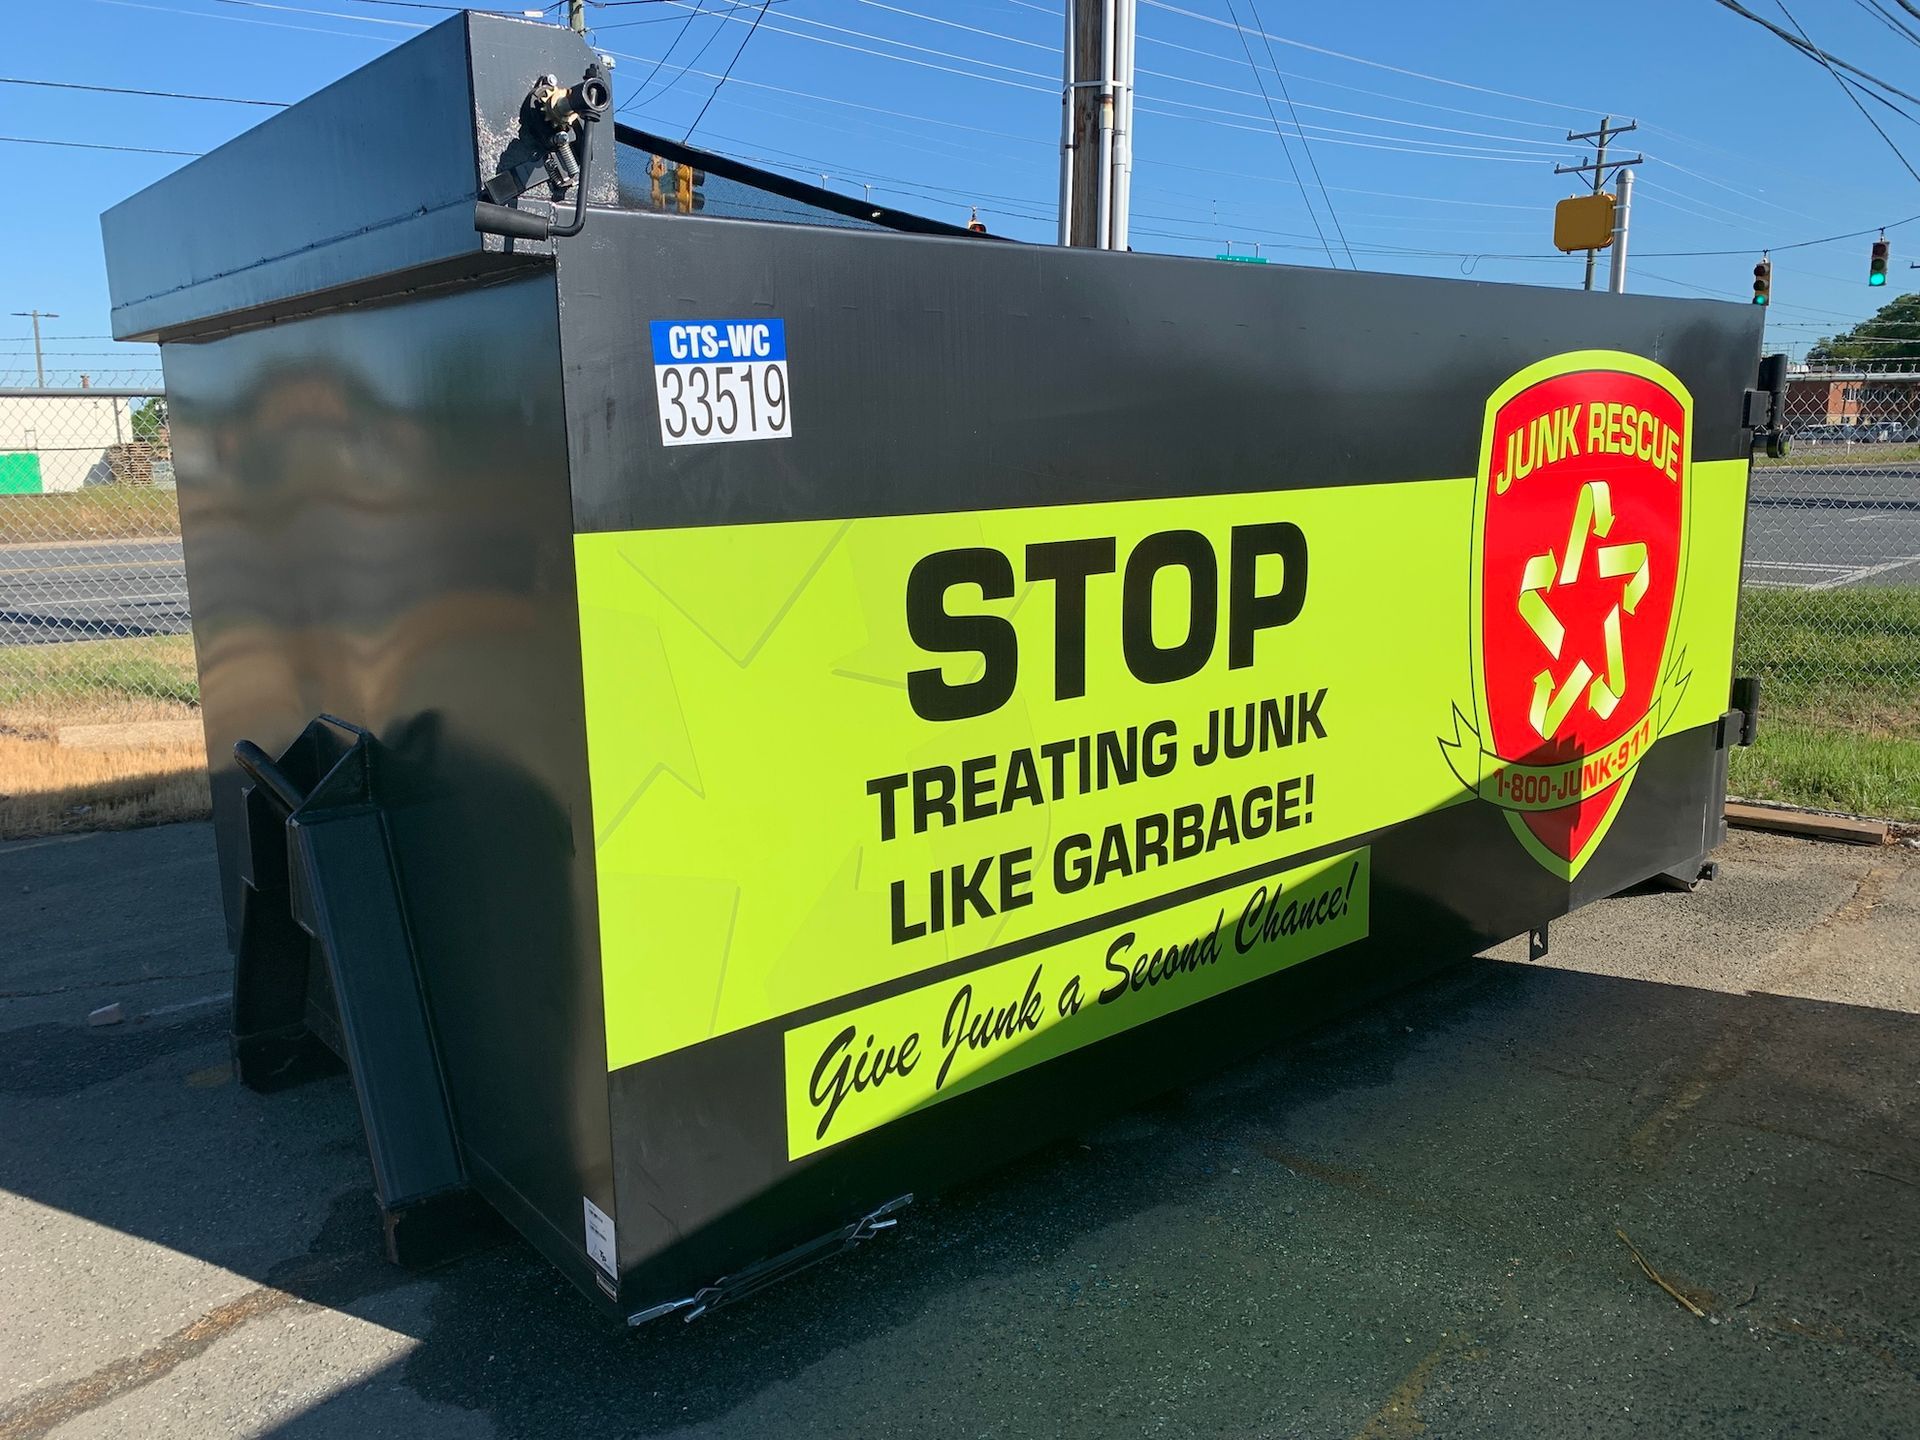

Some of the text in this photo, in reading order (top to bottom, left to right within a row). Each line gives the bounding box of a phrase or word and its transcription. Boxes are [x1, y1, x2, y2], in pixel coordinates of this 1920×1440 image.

[662, 364, 786, 438] 33519
[668, 324, 770, 359] CTS-WC
[1496, 401, 1680, 496] JUNK RESCUE
[906, 521, 1308, 722] STOP
[866, 687, 1329, 842] TREATING JUNK
[1493, 718, 1650, 804] 1-800-JUNK-911
[890, 773, 1315, 945] LIKE GARBAGE!
[809, 861, 1360, 1141] Give Junk a Second Chance!
